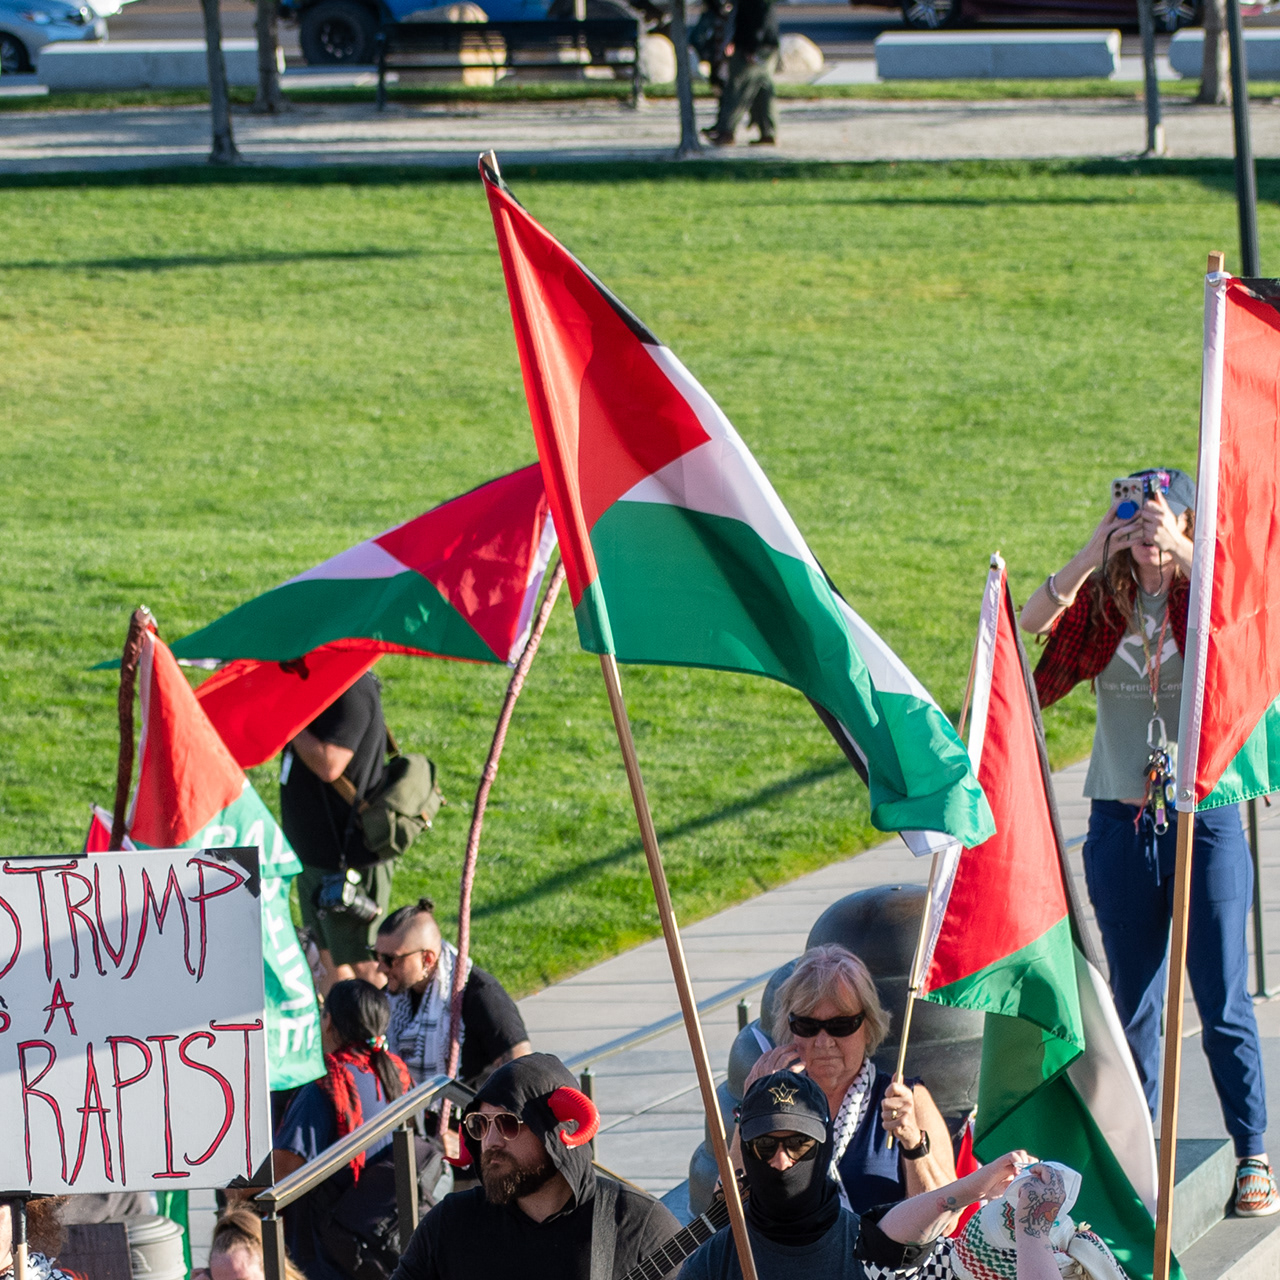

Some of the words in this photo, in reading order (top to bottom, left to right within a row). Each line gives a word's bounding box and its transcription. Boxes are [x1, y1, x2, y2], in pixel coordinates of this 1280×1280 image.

[3, 859, 245, 983] TRUMP
[43, 978, 79, 1036] A
[17, 1018, 264, 1186] RAPIST
